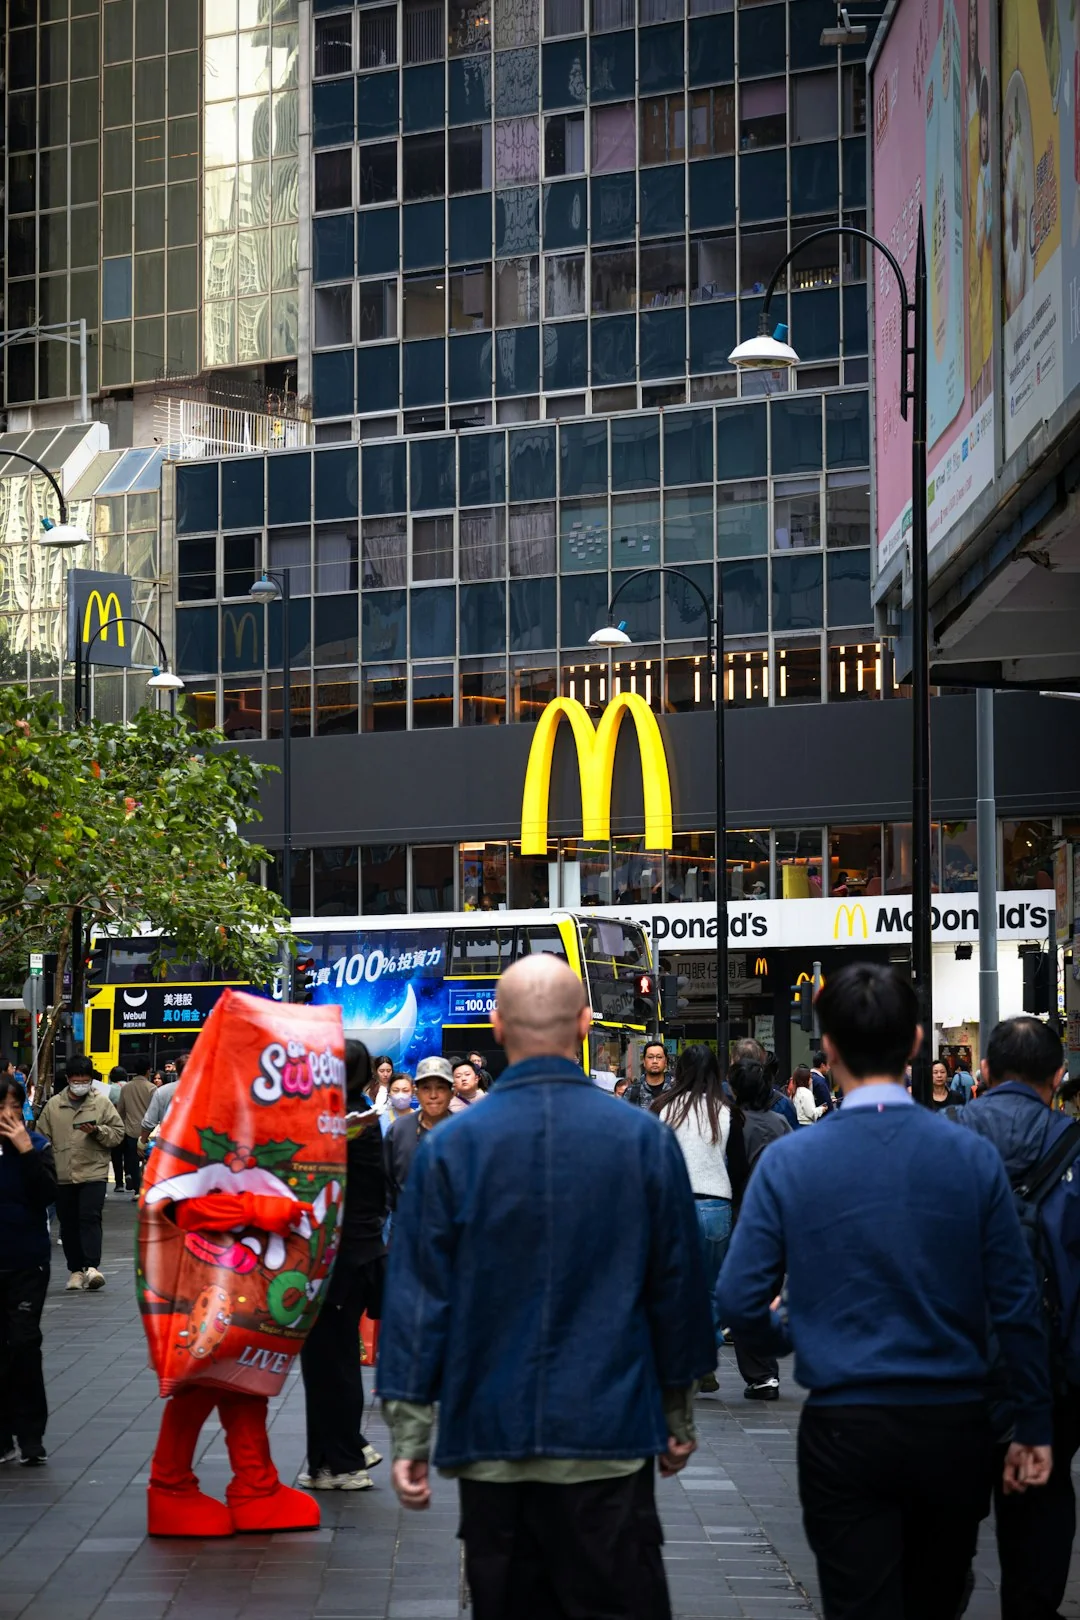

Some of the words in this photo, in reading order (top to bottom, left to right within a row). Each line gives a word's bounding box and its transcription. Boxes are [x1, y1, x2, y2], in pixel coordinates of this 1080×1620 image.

[613, 913, 768, 939] cDonad's
[875, 903, 1048, 933] Mconld's
[163, 993, 193, 1006] 美港股
[123, 1011, 147, 1020] Webull
[236, 1345, 288, 1375] LIVE
